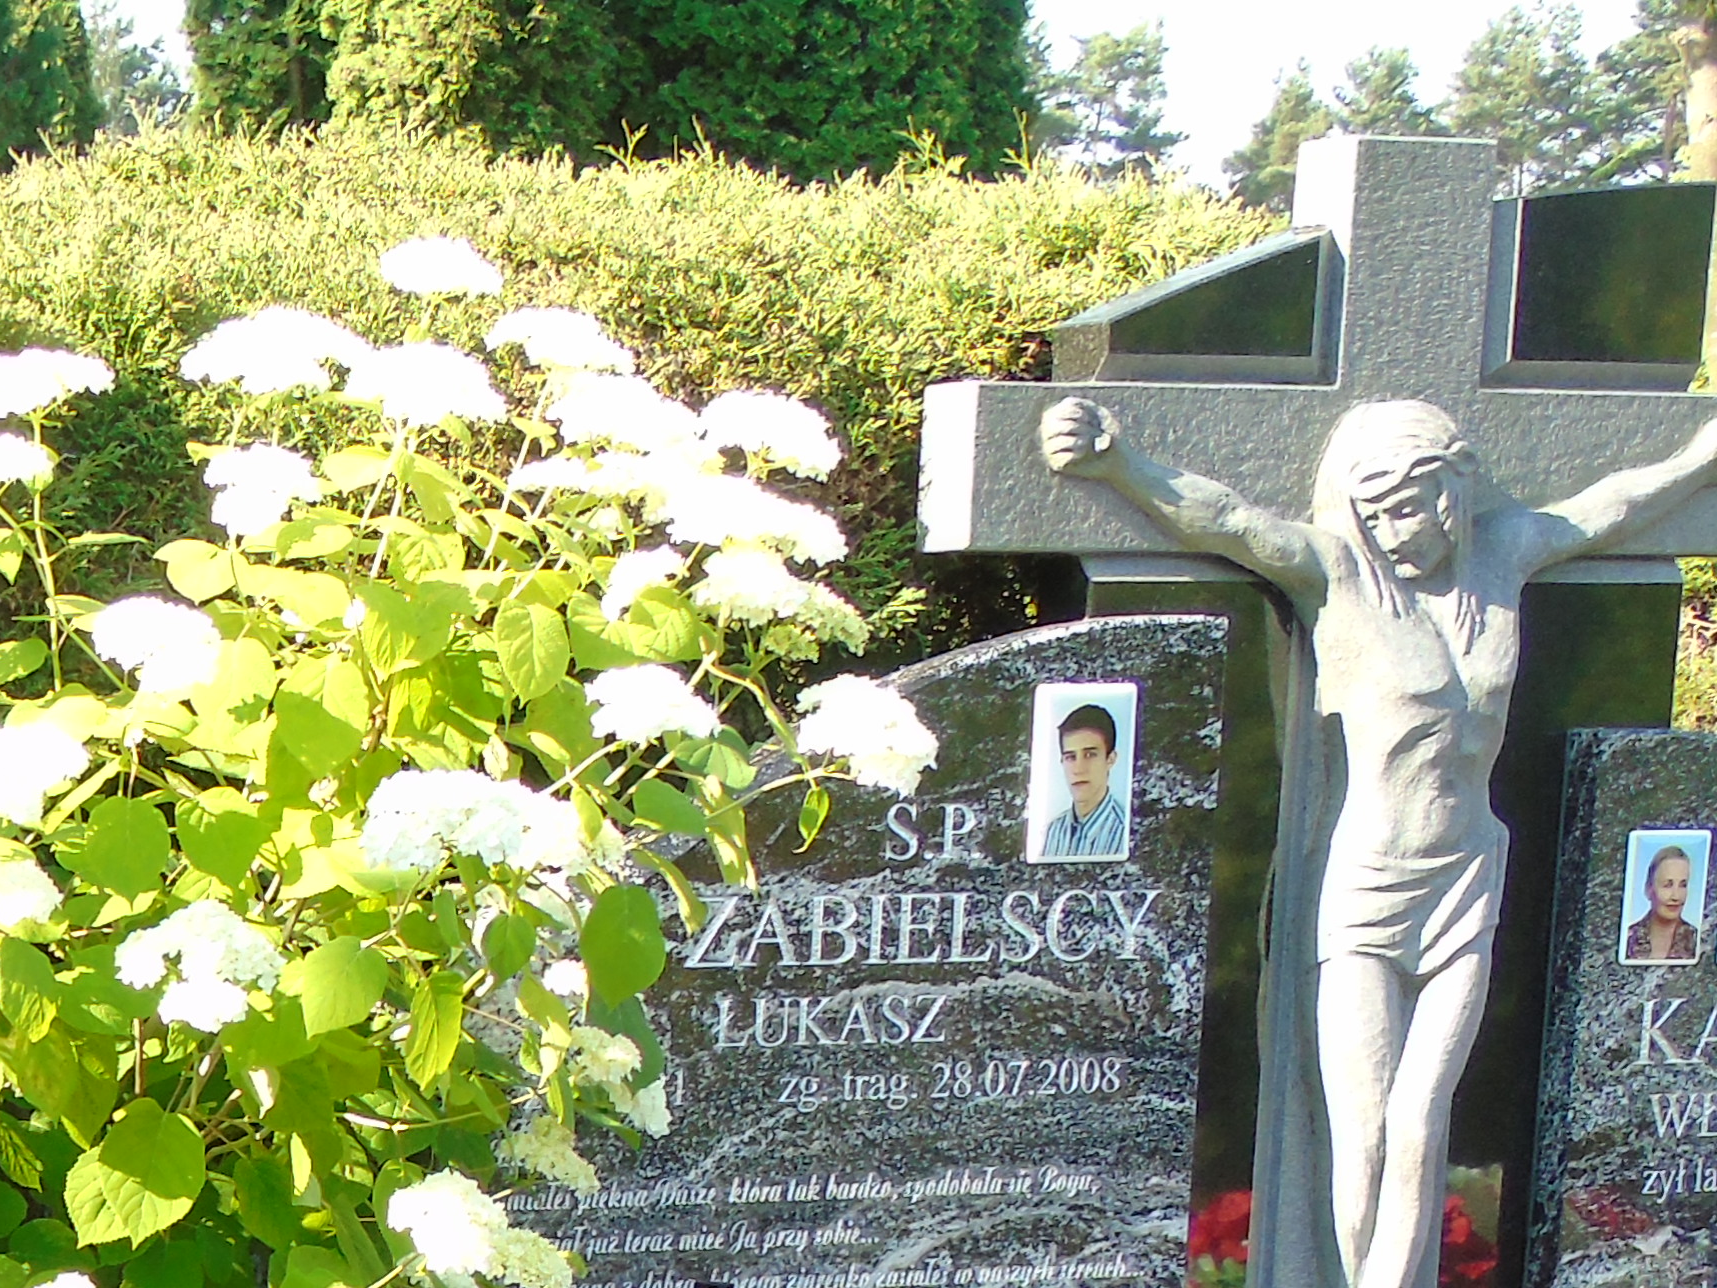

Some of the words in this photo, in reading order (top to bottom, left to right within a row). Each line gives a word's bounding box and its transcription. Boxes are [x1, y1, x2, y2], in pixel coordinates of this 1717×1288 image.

[683, 887, 1164, 970] ZABIELSCY
[716, 995, 948, 1048] ŁUKASZ
[779, 1073, 828, 1113] zg.
[843, 1069, 918, 1111] trag.
[932, 1057, 1122, 1100] 28.07.2008
[786, 1174, 820, 1201] tak
[624, 1230, 674, 1253] teraz
[760, 1229, 809, 1255] przy
